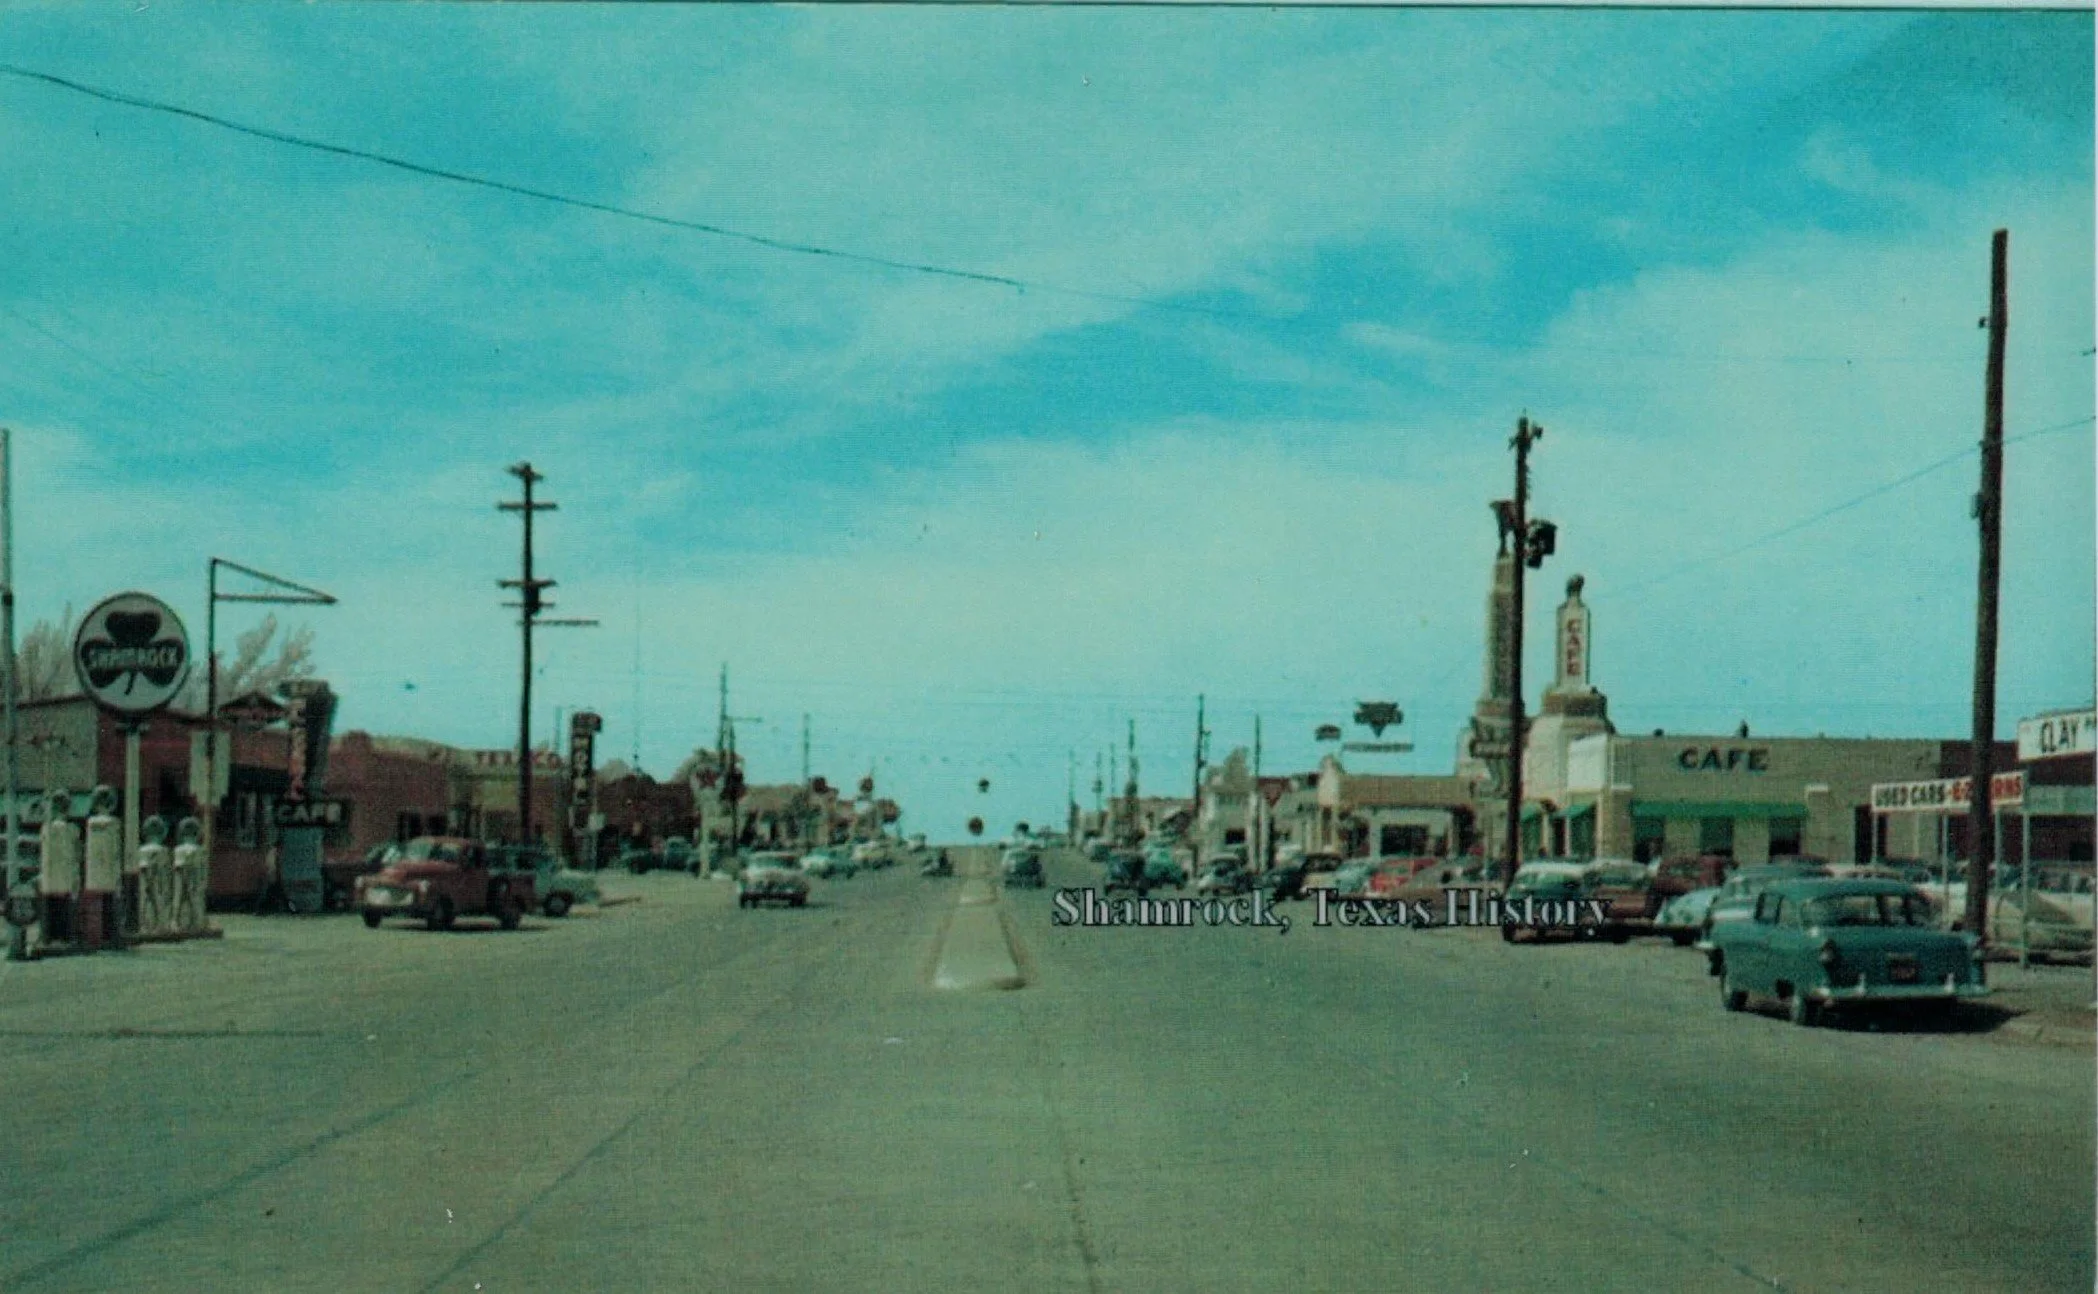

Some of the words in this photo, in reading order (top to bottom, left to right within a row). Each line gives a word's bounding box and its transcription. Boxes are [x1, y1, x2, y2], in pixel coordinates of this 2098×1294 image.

[89, 645, 179, 669] SHAMROCK
[1566, 618, 1582, 676] CAFE
[1678, 747, 1769, 772] CAFE
[1875, 785, 1909, 808] USED
[1911, 782, 1946, 806] CARS
[278, 802, 341, 823] CAFE
